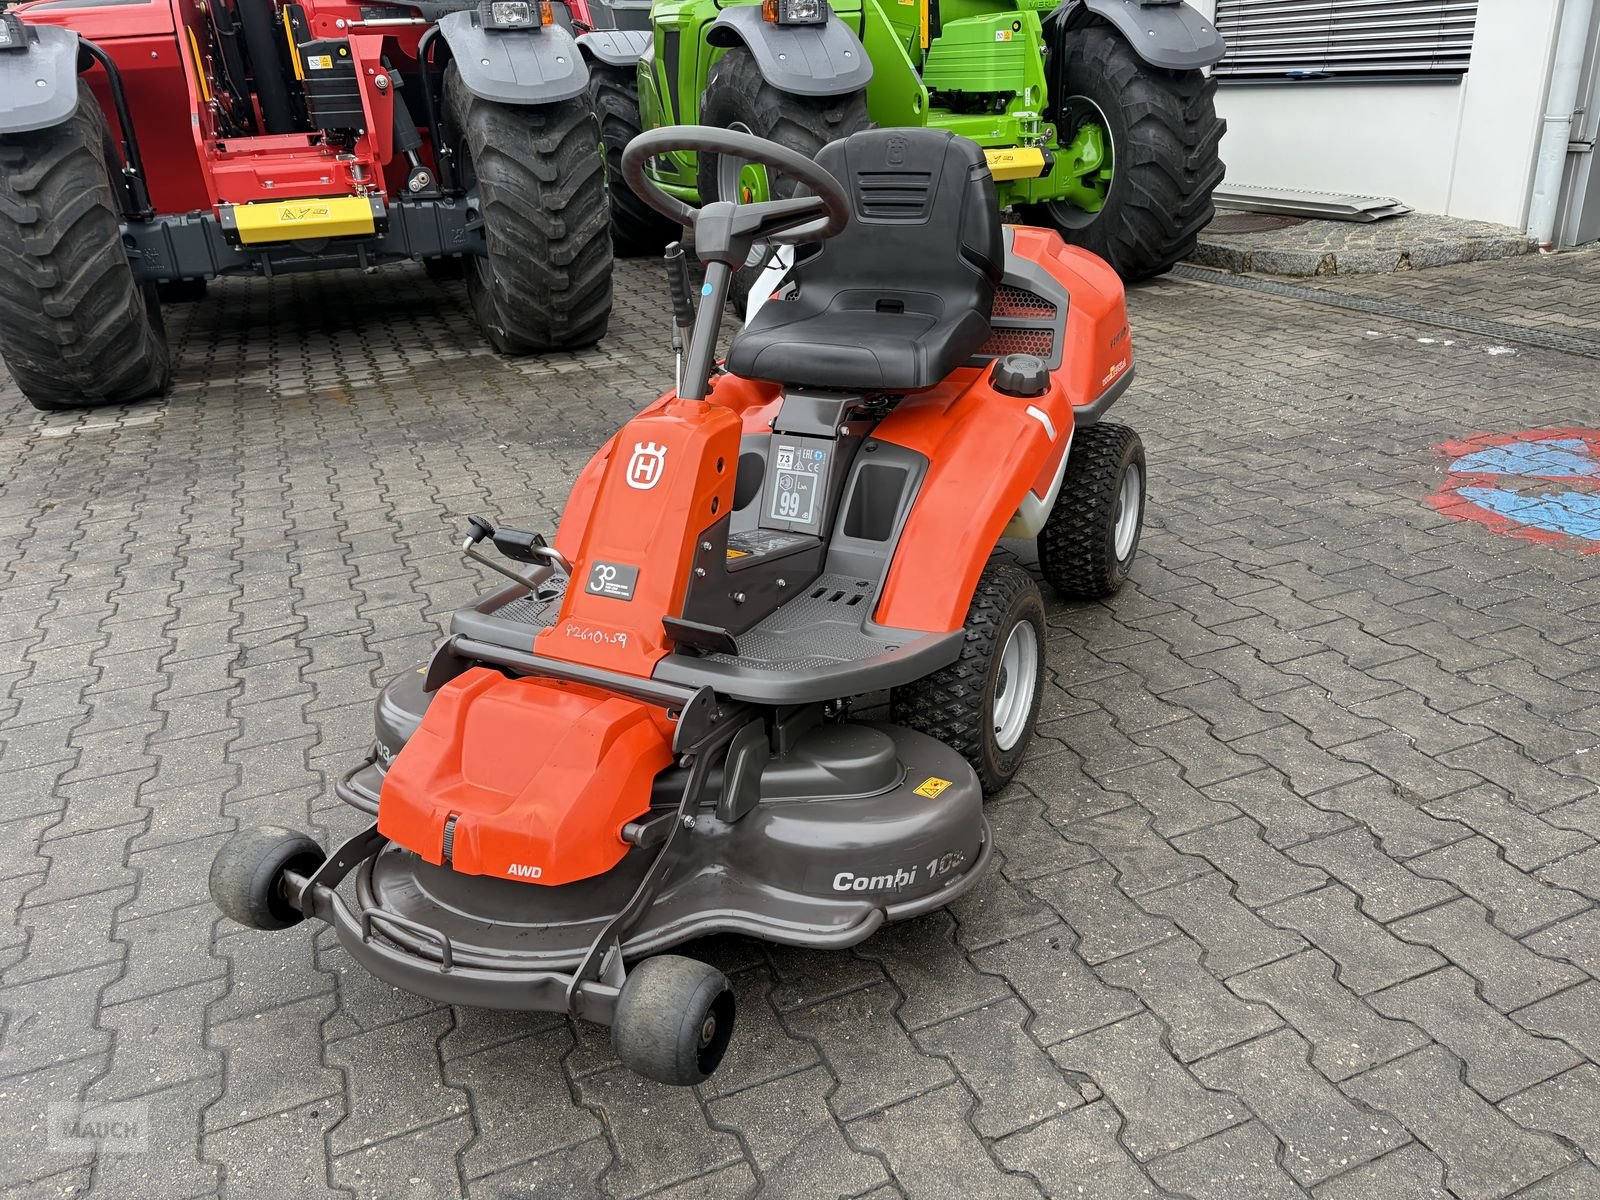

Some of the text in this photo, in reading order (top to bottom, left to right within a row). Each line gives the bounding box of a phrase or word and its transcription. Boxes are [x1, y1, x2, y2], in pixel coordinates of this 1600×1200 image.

[779, 454, 791, 463] 73
[807, 462, 820, 472] CE
[779, 491, 800, 516] 99
[507, 863, 542, 879] AWD
[832, 865, 918, 891] Combi
